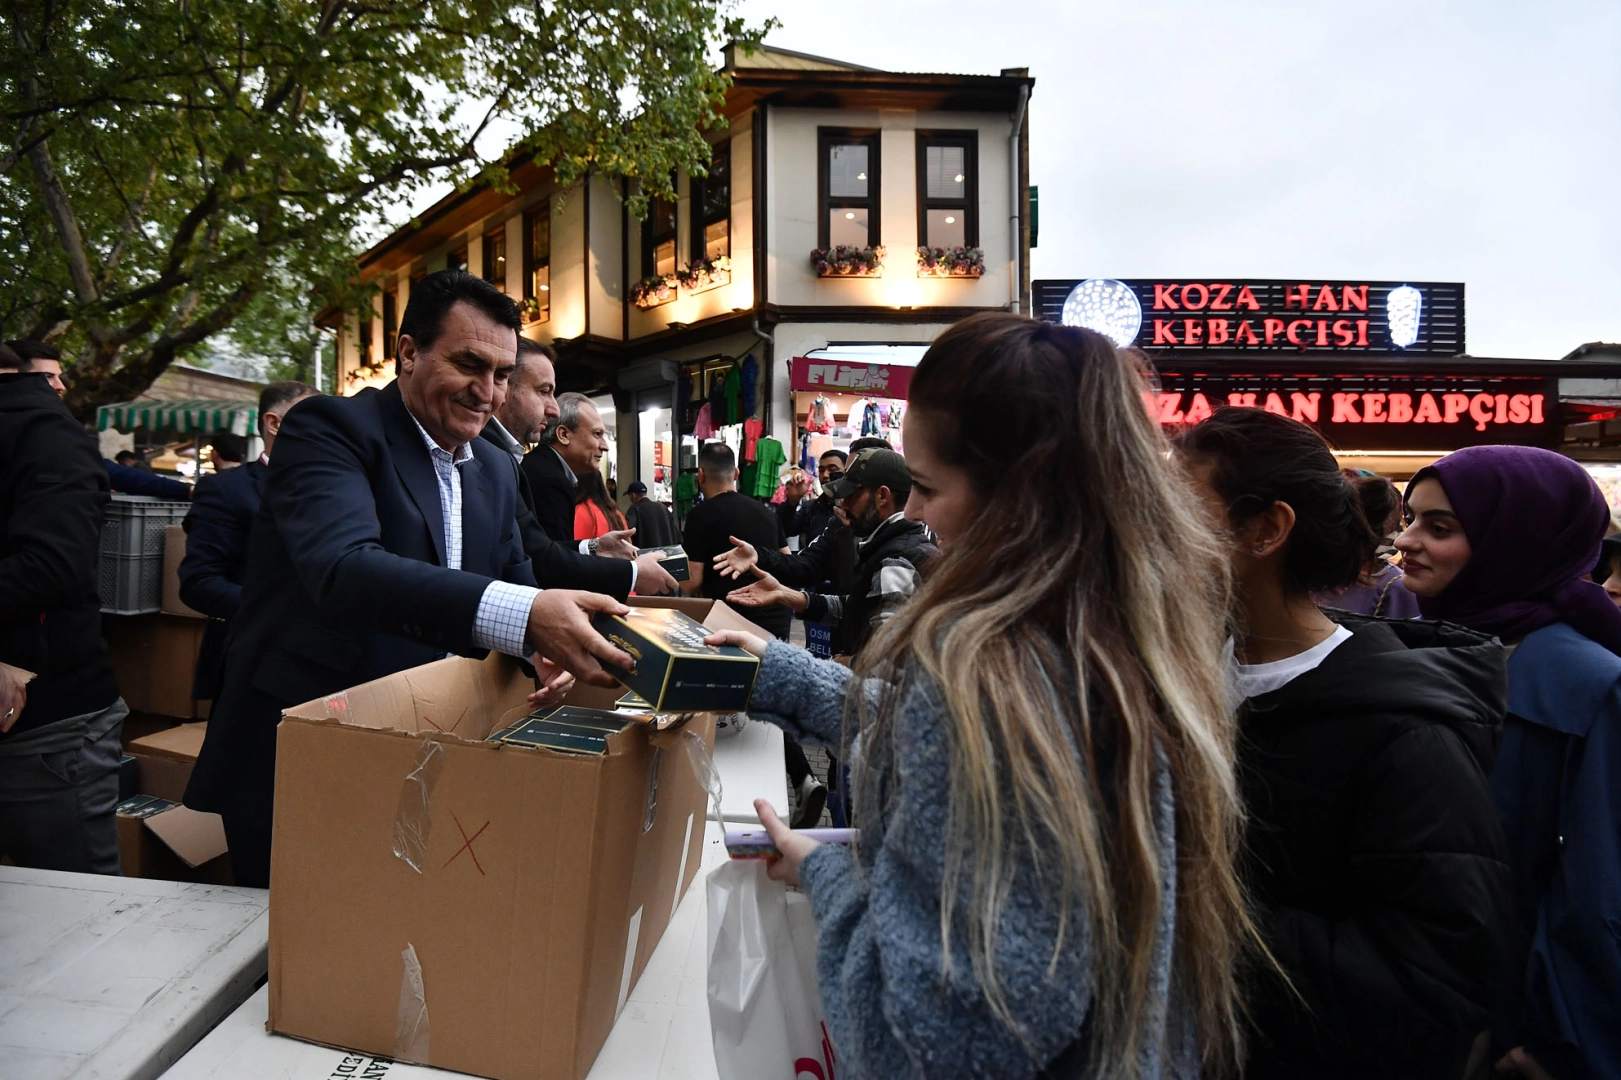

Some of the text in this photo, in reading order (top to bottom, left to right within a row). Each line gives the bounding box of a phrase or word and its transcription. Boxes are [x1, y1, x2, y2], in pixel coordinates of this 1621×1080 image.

[1152, 283, 1370, 311] KOZA HAN
[1152, 318, 1370, 352] KEBAPÇISI
[1142, 392, 1213, 424] ZA
[1331, 393, 1544, 431] KEBAPÇISI
